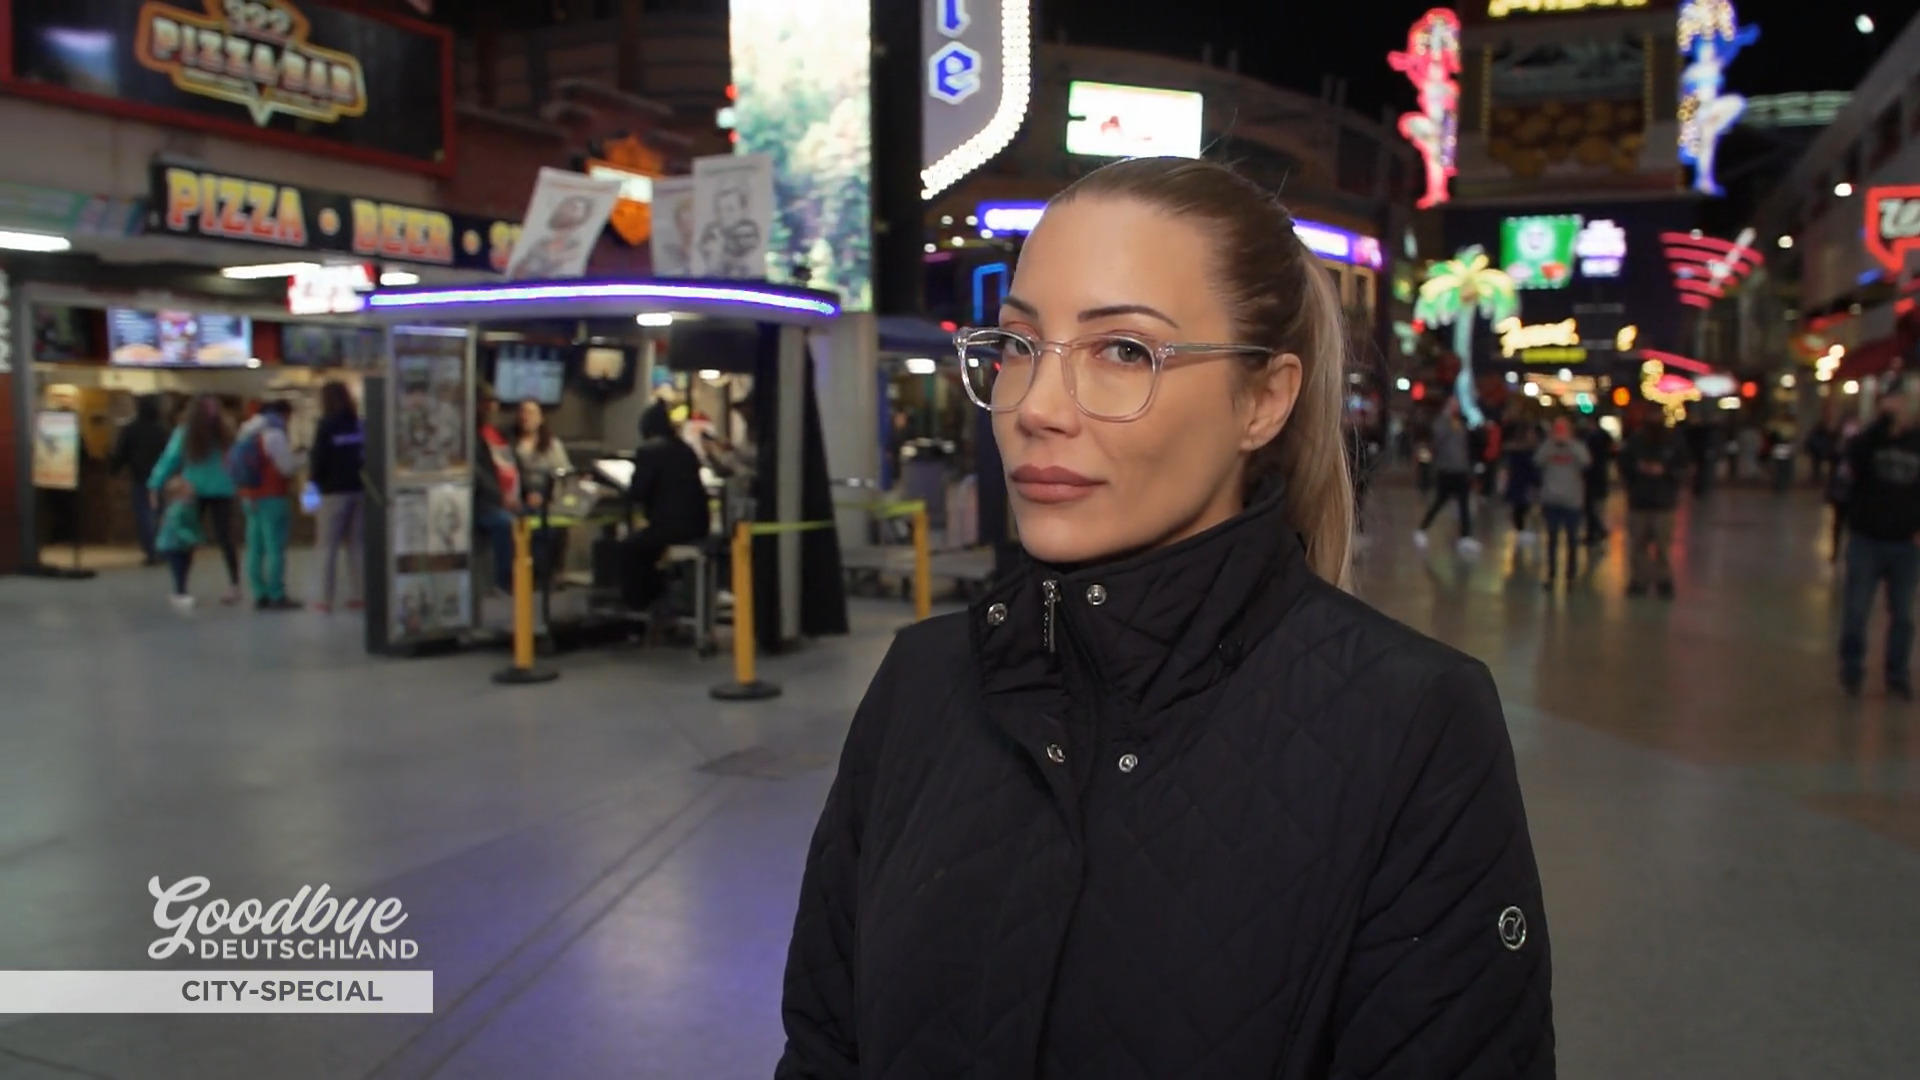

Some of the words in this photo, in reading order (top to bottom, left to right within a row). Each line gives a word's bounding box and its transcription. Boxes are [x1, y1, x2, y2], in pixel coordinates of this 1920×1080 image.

[152, 16, 277, 86] PIZZA
[166, 168, 307, 248] PIZZA
[352, 198, 454, 264] BEER
